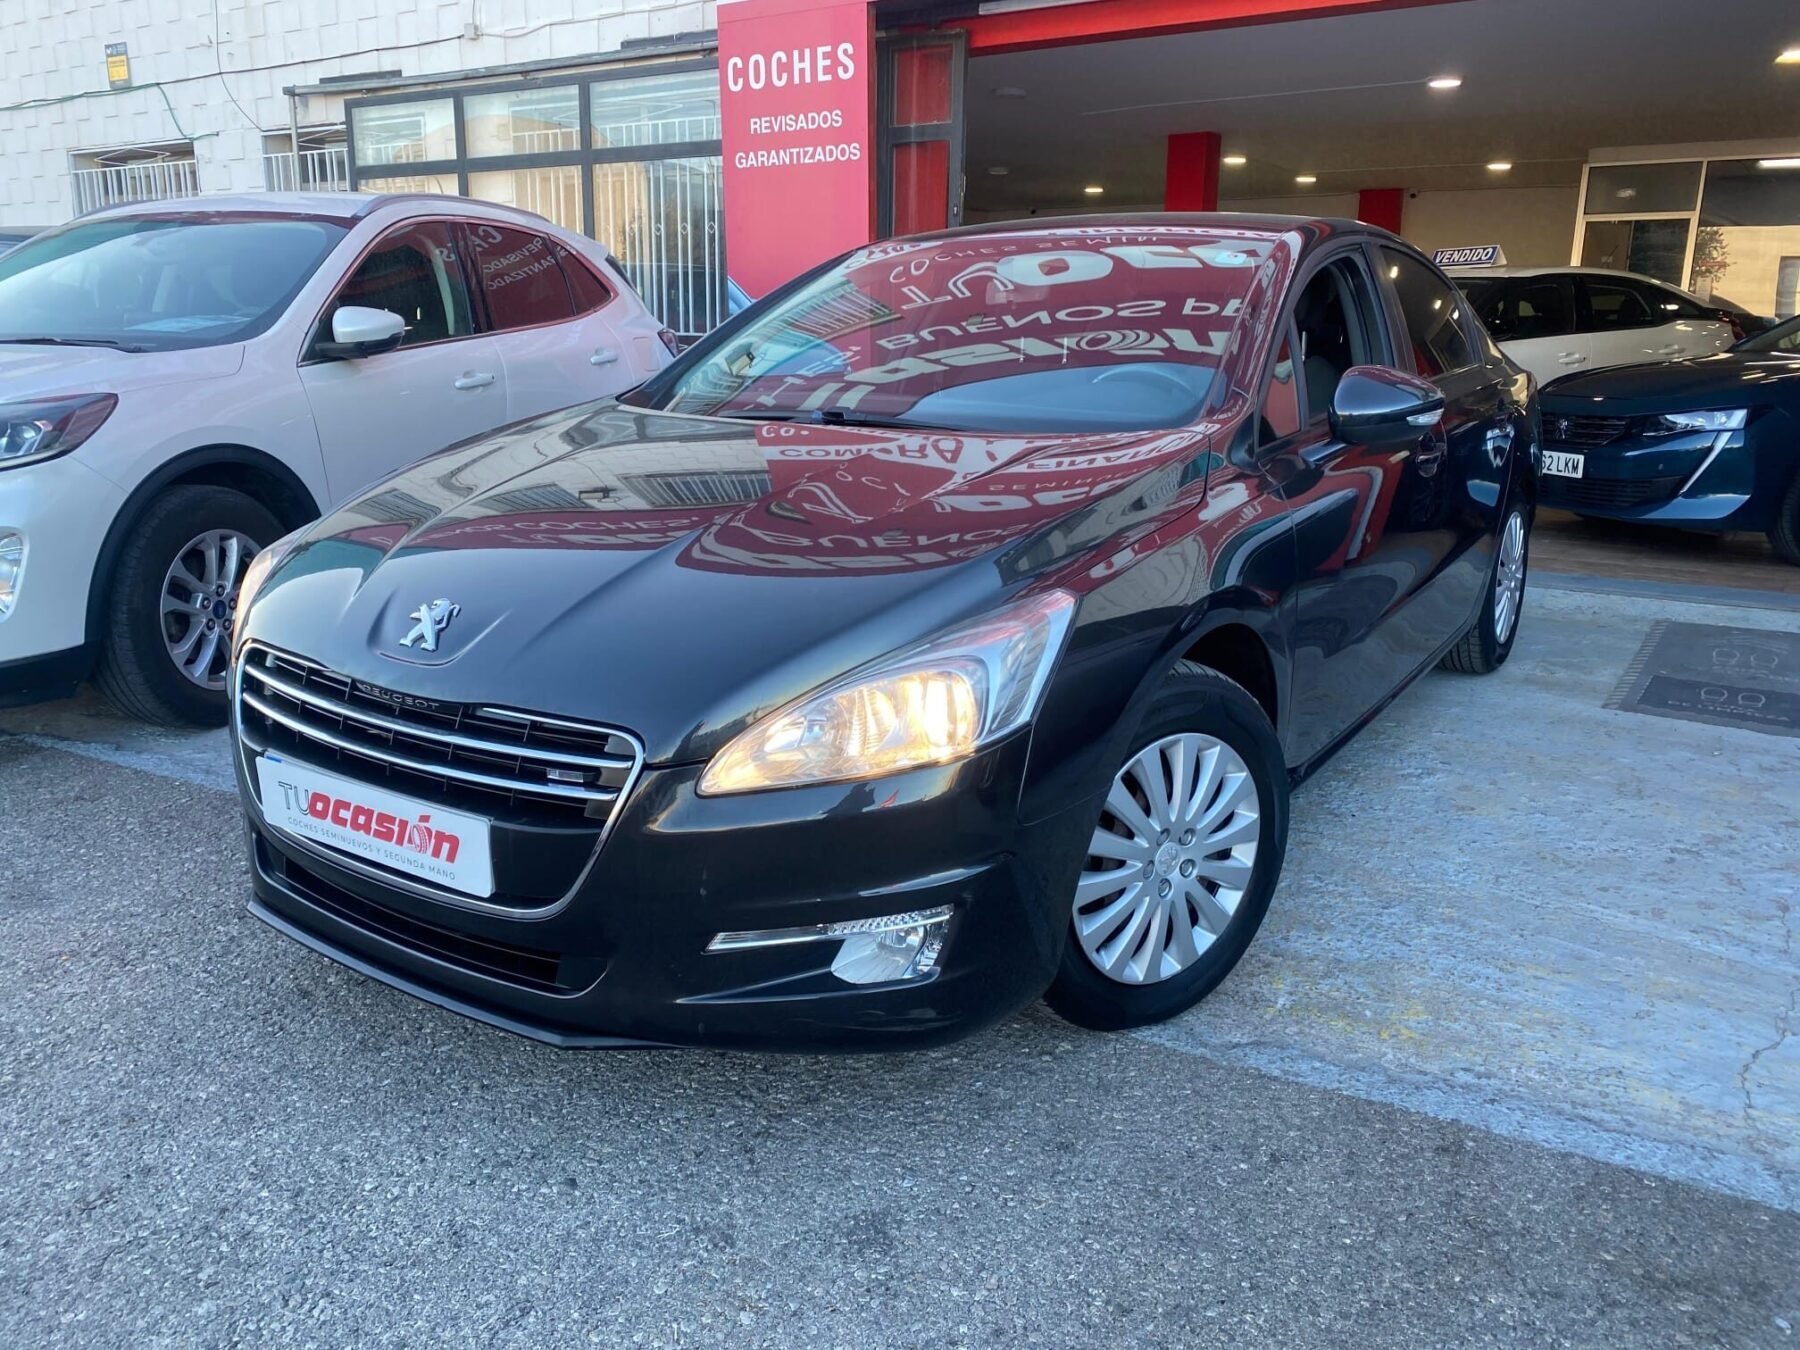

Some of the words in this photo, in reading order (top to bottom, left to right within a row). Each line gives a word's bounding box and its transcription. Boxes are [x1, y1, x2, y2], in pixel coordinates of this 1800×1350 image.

[727, 42, 855, 92] COCHES
[750, 109, 843, 135] REVISADOS
[735, 143, 861, 169] GARANTIZADOS
[1436, 247, 1494, 263] VENDIDO
[1556, 456, 1580, 475] LKM
[361, 683, 440, 709] PEUGEOT
[287, 816, 319, 833] COCHES
[320, 828, 374, 852] SEMINUEVOS
[375, 845, 381, 855] Y
[383, 849, 426, 869] SEGUNDA
[428, 865, 456, 881] MANO
